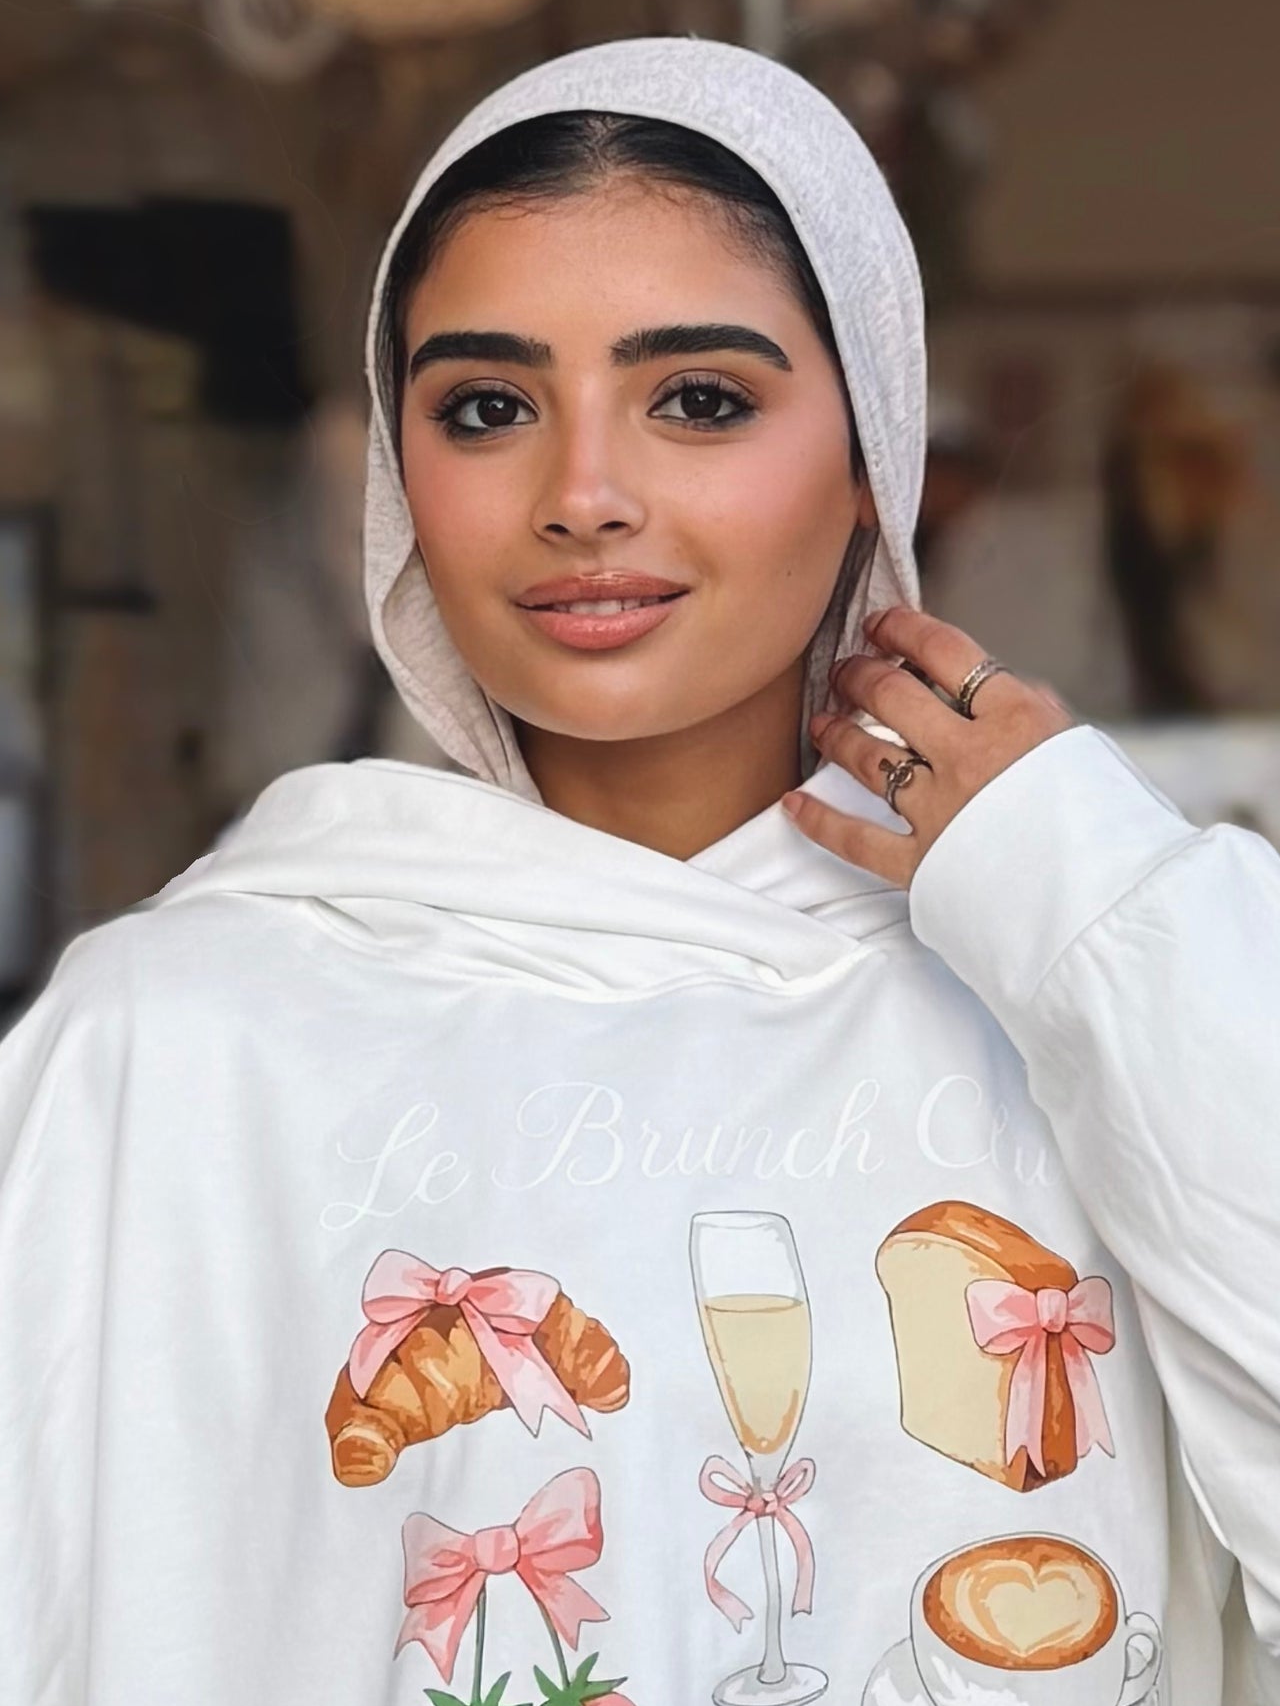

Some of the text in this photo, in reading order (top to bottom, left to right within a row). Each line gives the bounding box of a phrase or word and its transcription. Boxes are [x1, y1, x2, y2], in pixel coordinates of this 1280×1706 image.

[318, 1074, 1060, 1231] Le Brunch Clu
